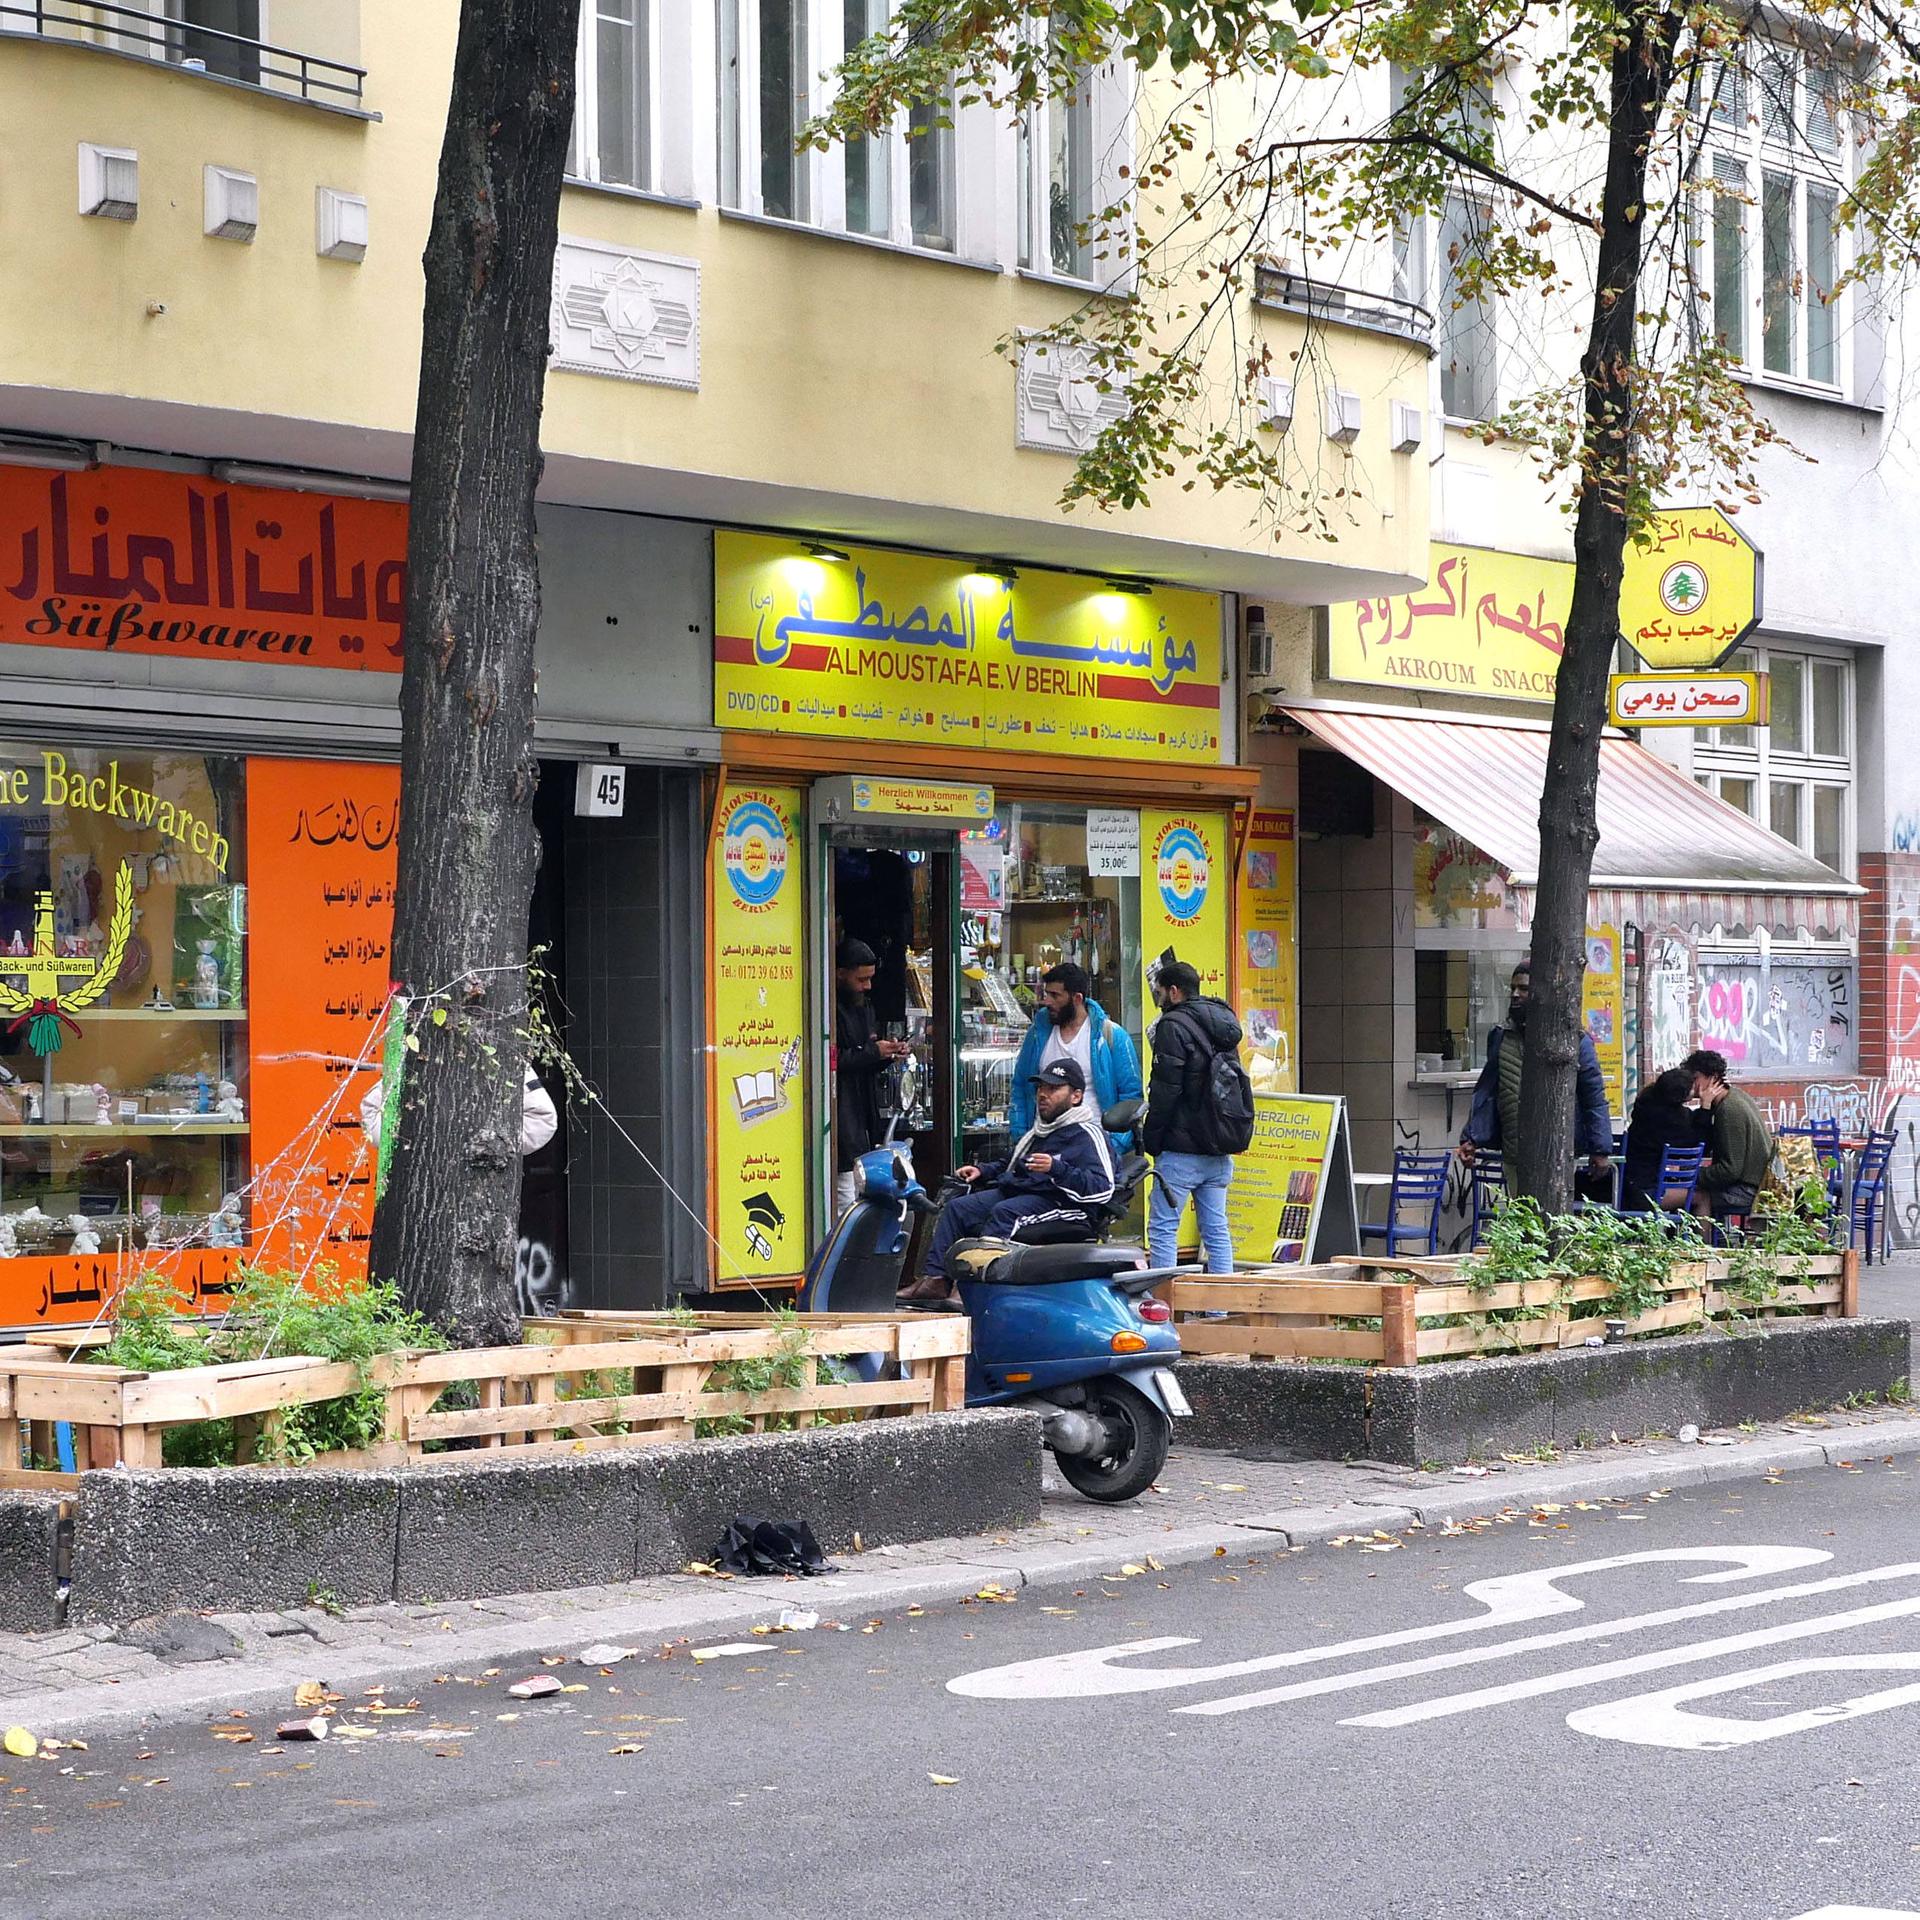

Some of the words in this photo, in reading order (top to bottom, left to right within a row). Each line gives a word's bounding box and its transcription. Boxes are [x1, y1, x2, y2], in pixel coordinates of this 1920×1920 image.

[1688, 522, 1738, 548] مطعم
[25, 597, 318, 656] Süßwaren
[756, 565, 975, 665] المصطفى
[1476, 588, 1565, 657] طعم
[1636, 618, 1672, 644] بكم
[1678, 621, 1738, 641] يرحب
[826, 646, 982, 688] ALMOUSTAFA
[986, 661, 1021, 691] E.V
[1025, 666, 1096, 699] BERLIN
[1383, 655, 1477, 685] AKROUM
[1491, 667, 1557, 694] SNACK
[727, 691, 780, 718] DVD/CD
[1623, 692, 1677, 715] يومي
[1682, 684, 1741, 711] صحن
[597, 775, 621, 805] 45
[878, 786, 914, 798] Herzlich
[916, 789, 968, 801] Willkommen
[40, 751, 230, 875] Backwaren
[731, 898, 779, 914] BERLIN
[1164, 914, 1202, 928] BERLIN
[26, 961, 44, 972] und
[46, 960, 94, 972] Süßwaren
[738, 965, 756, 979] 0172
[758, 966, 768, 979] 39
[769, 966, 778, 979] 62
[1254, 1125, 1321, 1141] LLKOMMEN
